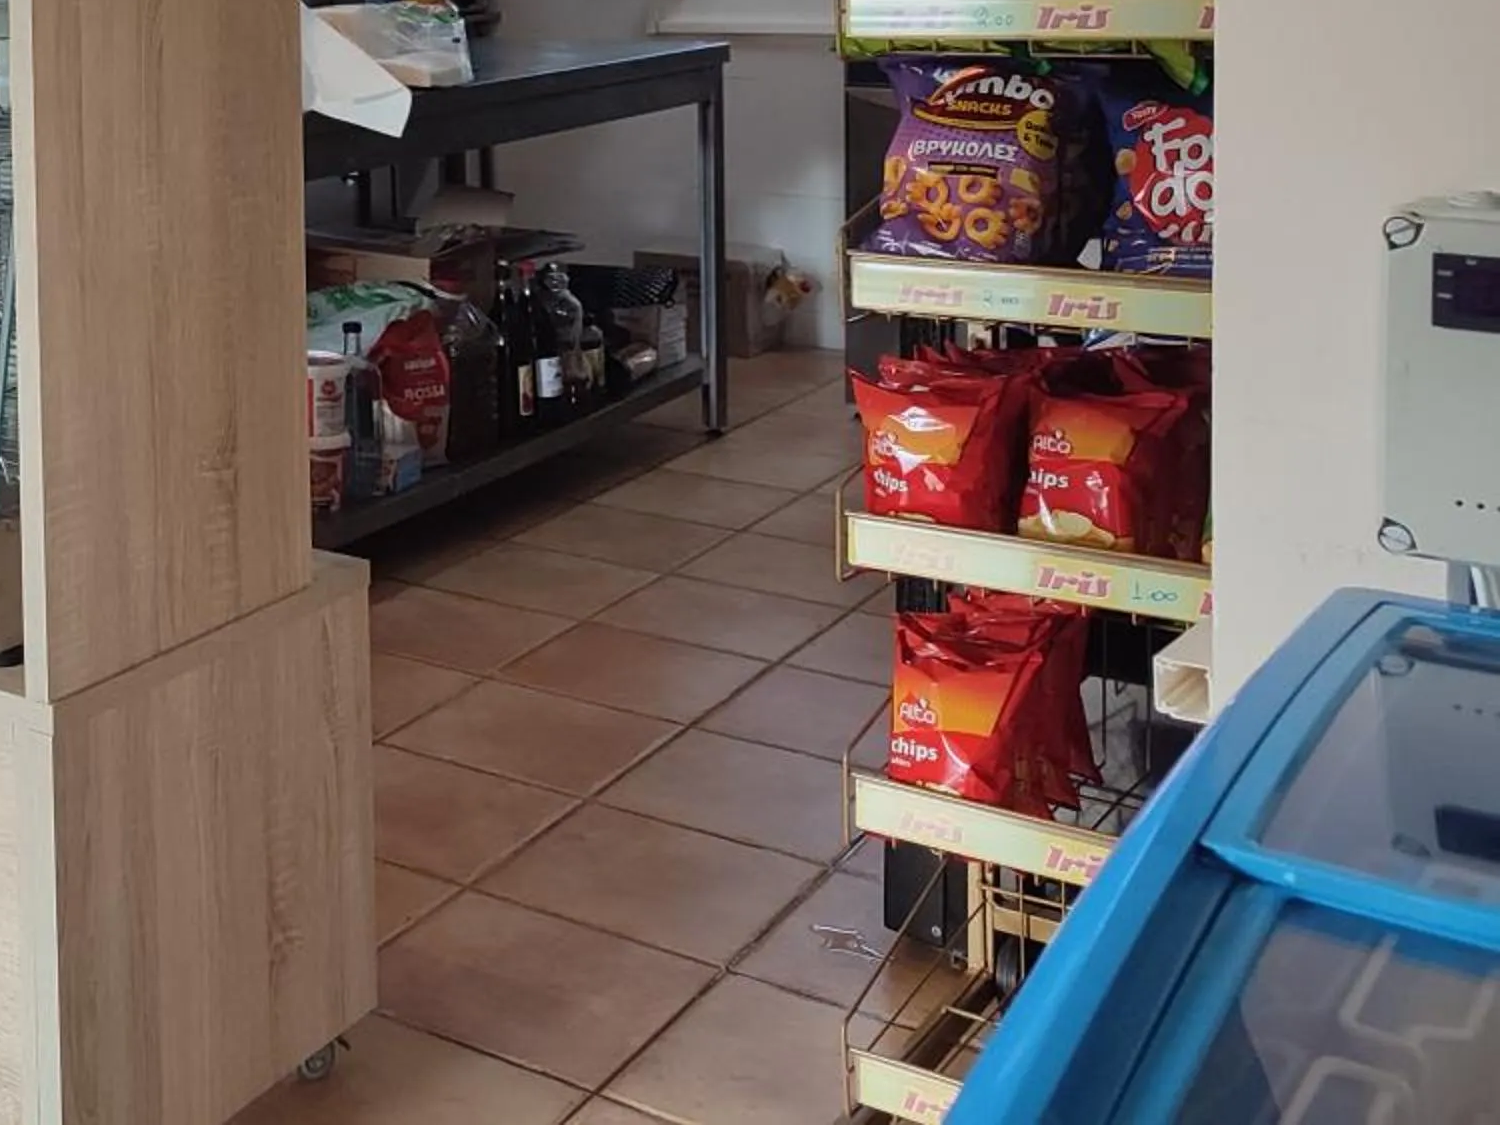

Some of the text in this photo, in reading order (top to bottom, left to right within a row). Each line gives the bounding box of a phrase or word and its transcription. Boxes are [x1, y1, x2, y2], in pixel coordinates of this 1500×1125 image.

[1036, 4, 1113, 30] Iris
[1047, 294, 1122, 320] Iris
[891, 737, 939, 762] chips
